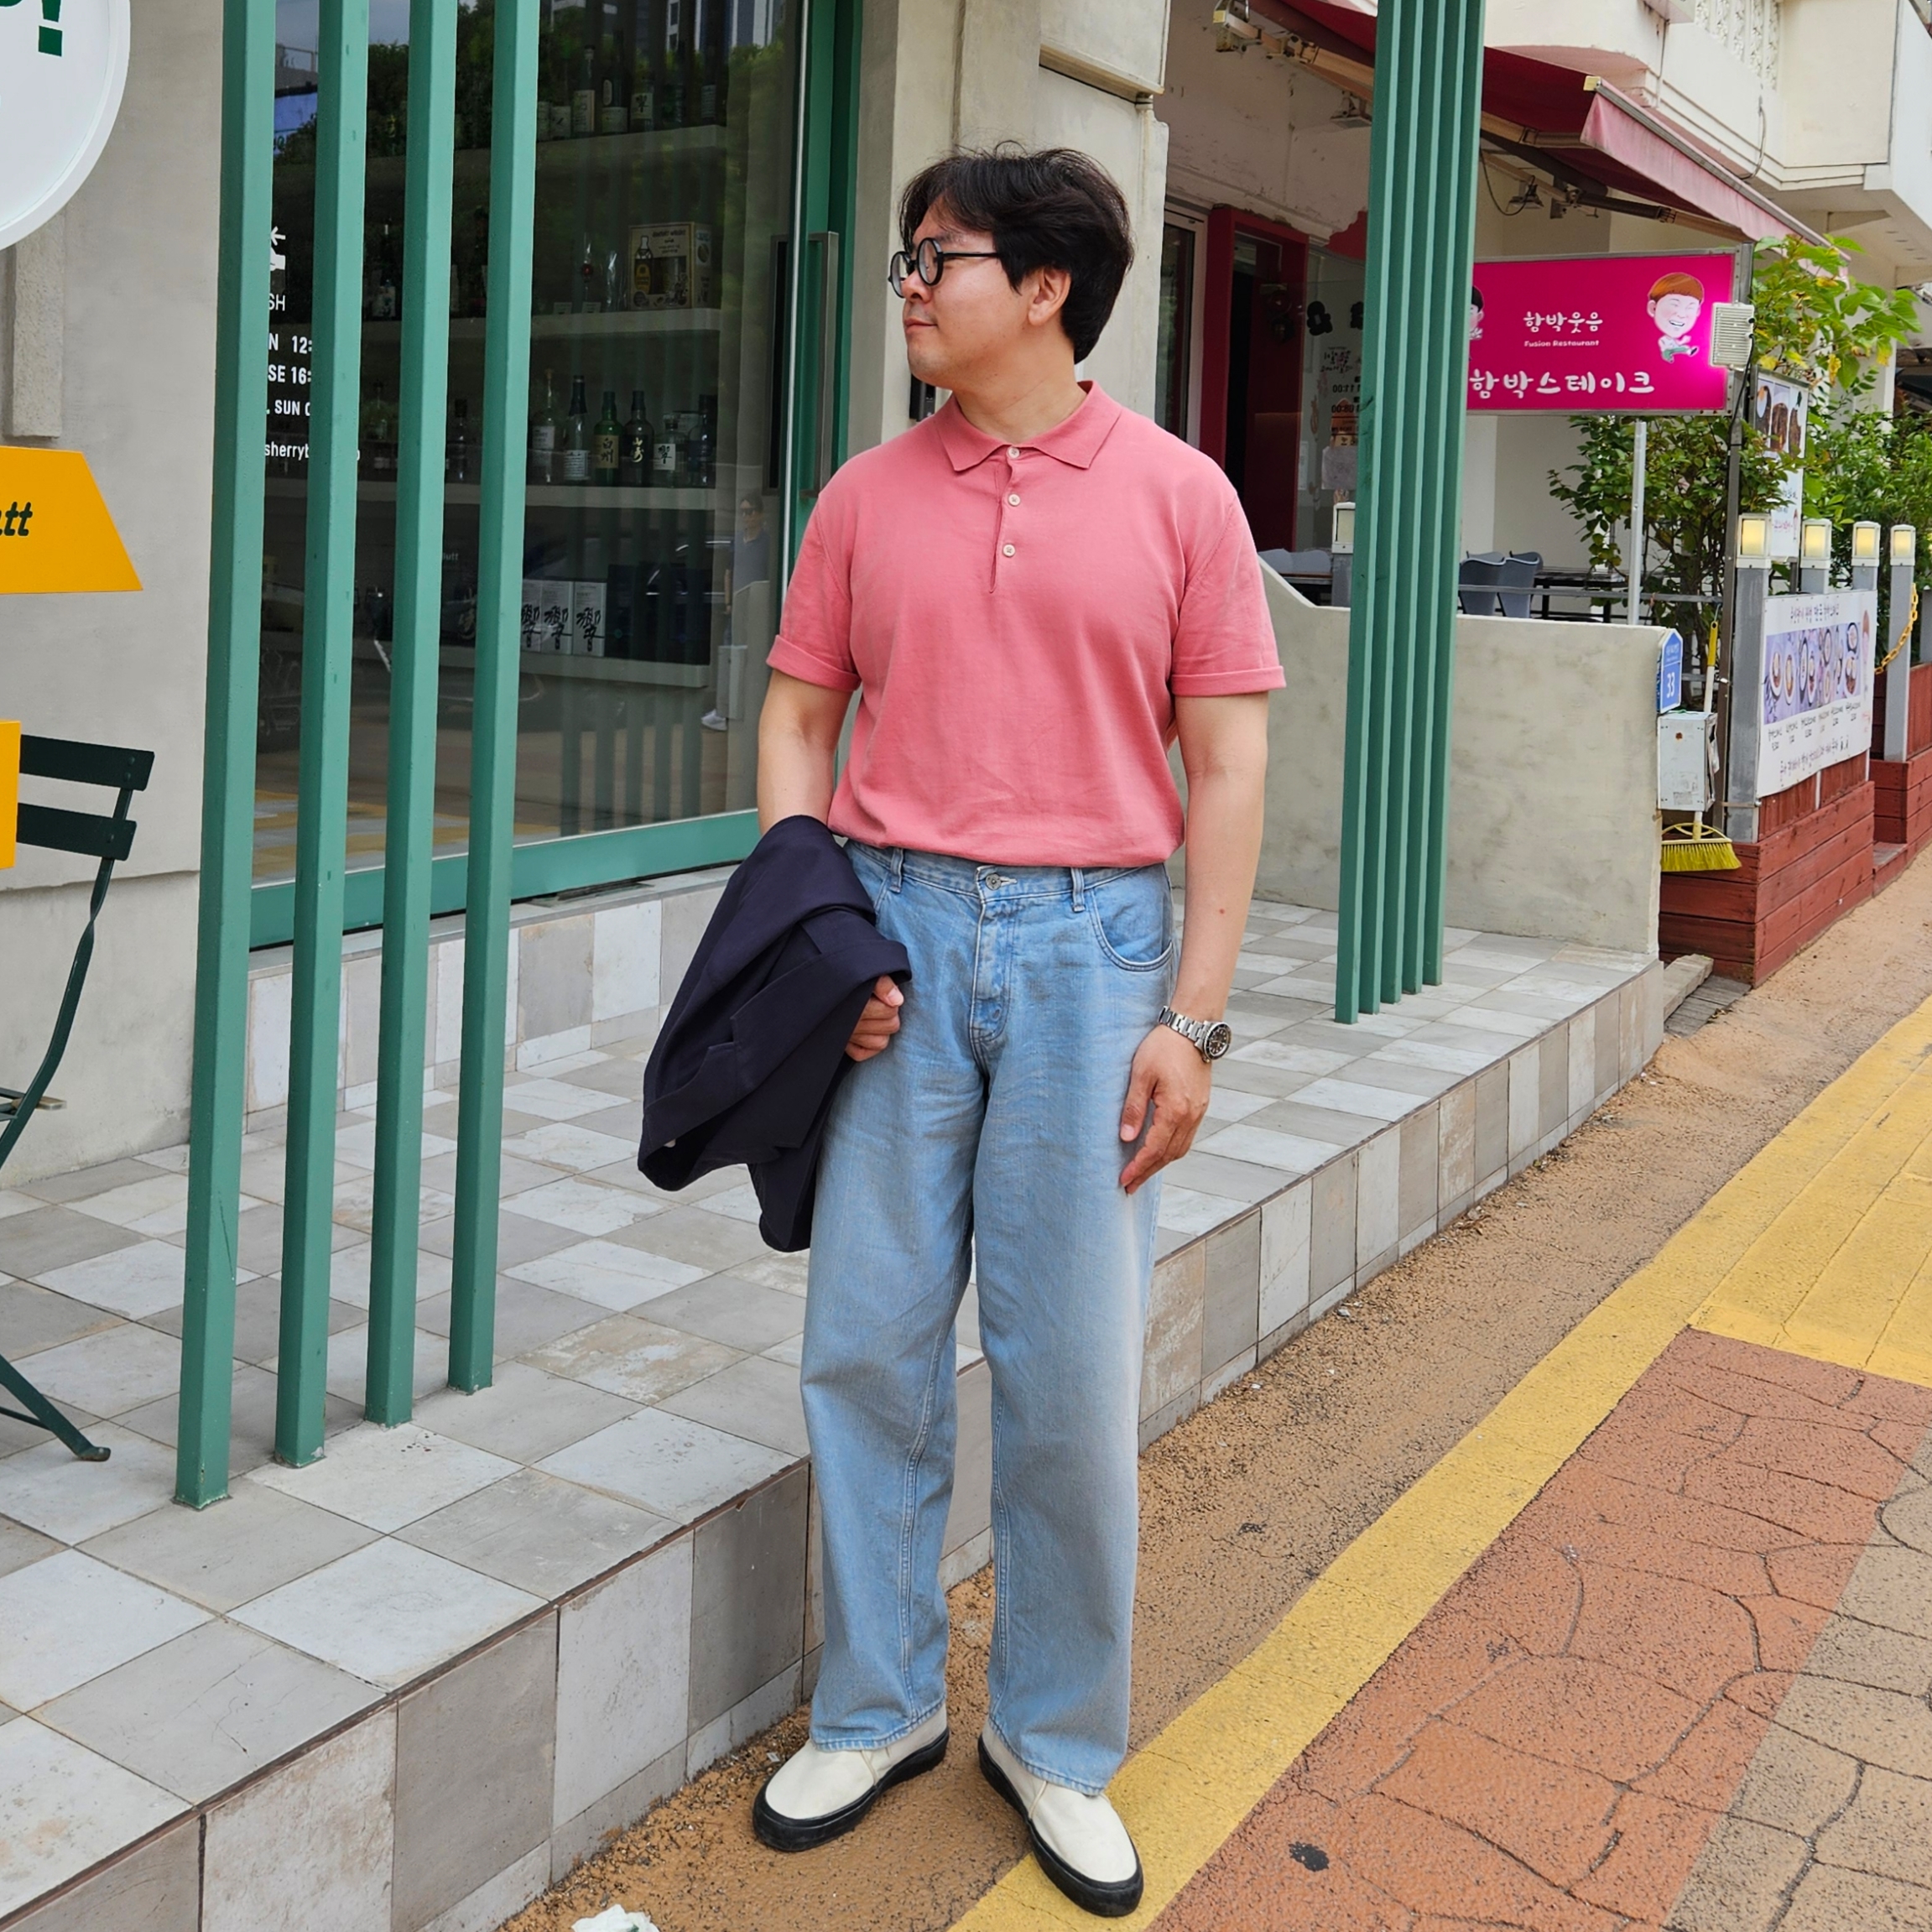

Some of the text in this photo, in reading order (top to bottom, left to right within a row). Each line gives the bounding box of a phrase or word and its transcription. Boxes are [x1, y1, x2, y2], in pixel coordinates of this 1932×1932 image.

[1523, 311, 1603, 333] 함박웃음
[1552, 339, 1600, 347] Restaurant
[274, 399, 300, 416] SUN
[0, 501, 34, 537] tt
[1666, 671, 1675, 699] 33
